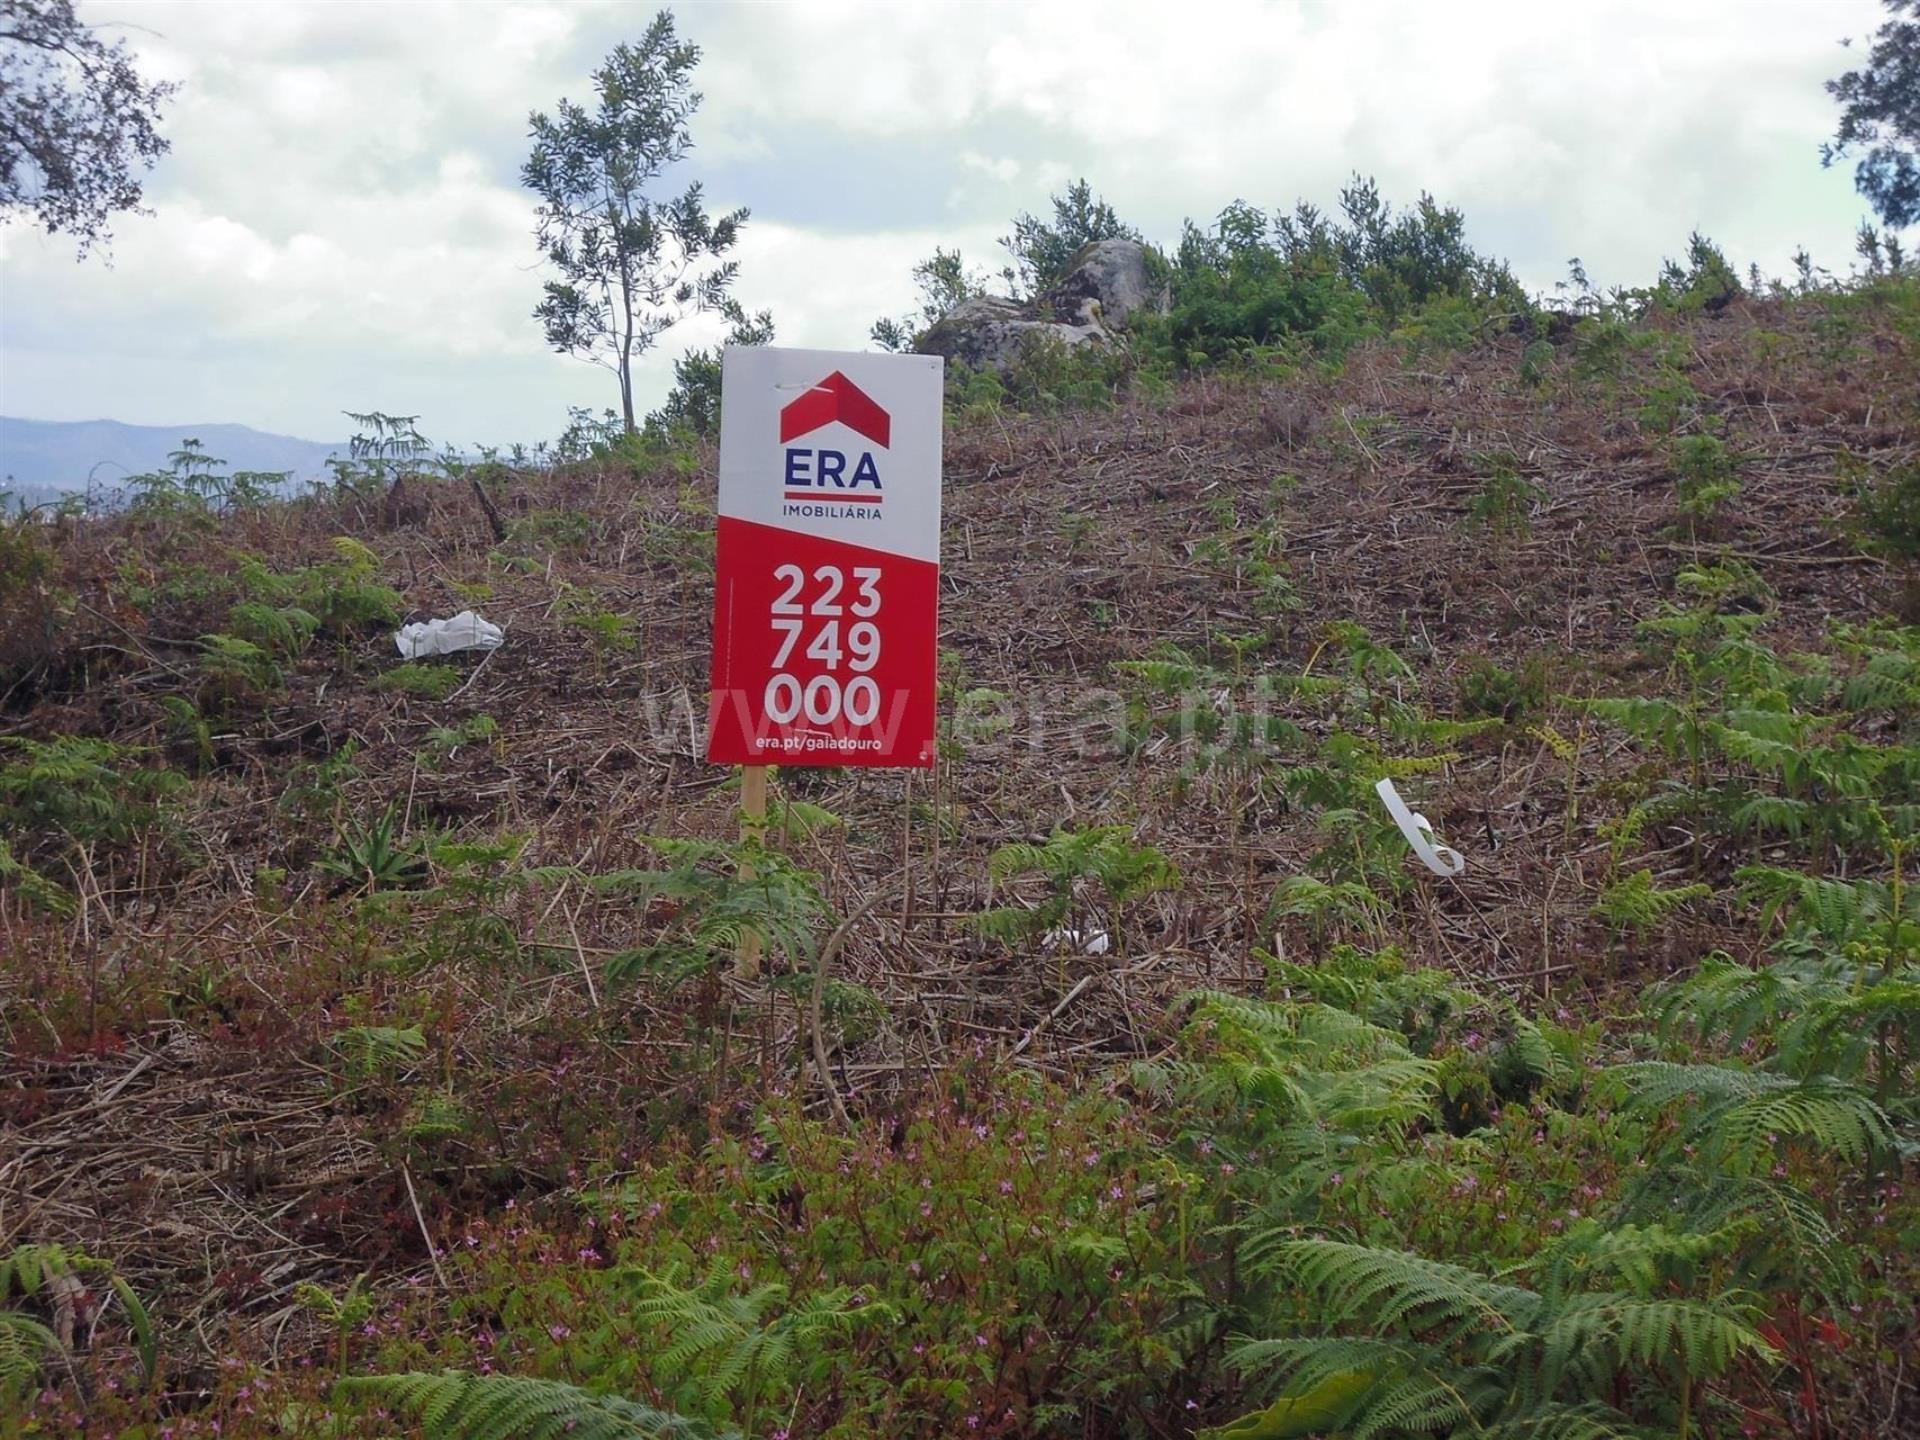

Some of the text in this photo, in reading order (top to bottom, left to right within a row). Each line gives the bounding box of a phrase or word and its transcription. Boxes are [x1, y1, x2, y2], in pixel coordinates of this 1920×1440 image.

[784, 447, 882, 490] ERA
[783, 504, 882, 521] IMOBILIÁRIA
[771, 564, 882, 617] 223
[771, 619, 881, 672] 749
[764, 674, 881, 726] 000
[755, 734, 882, 752] era.pt/gaiadouro
